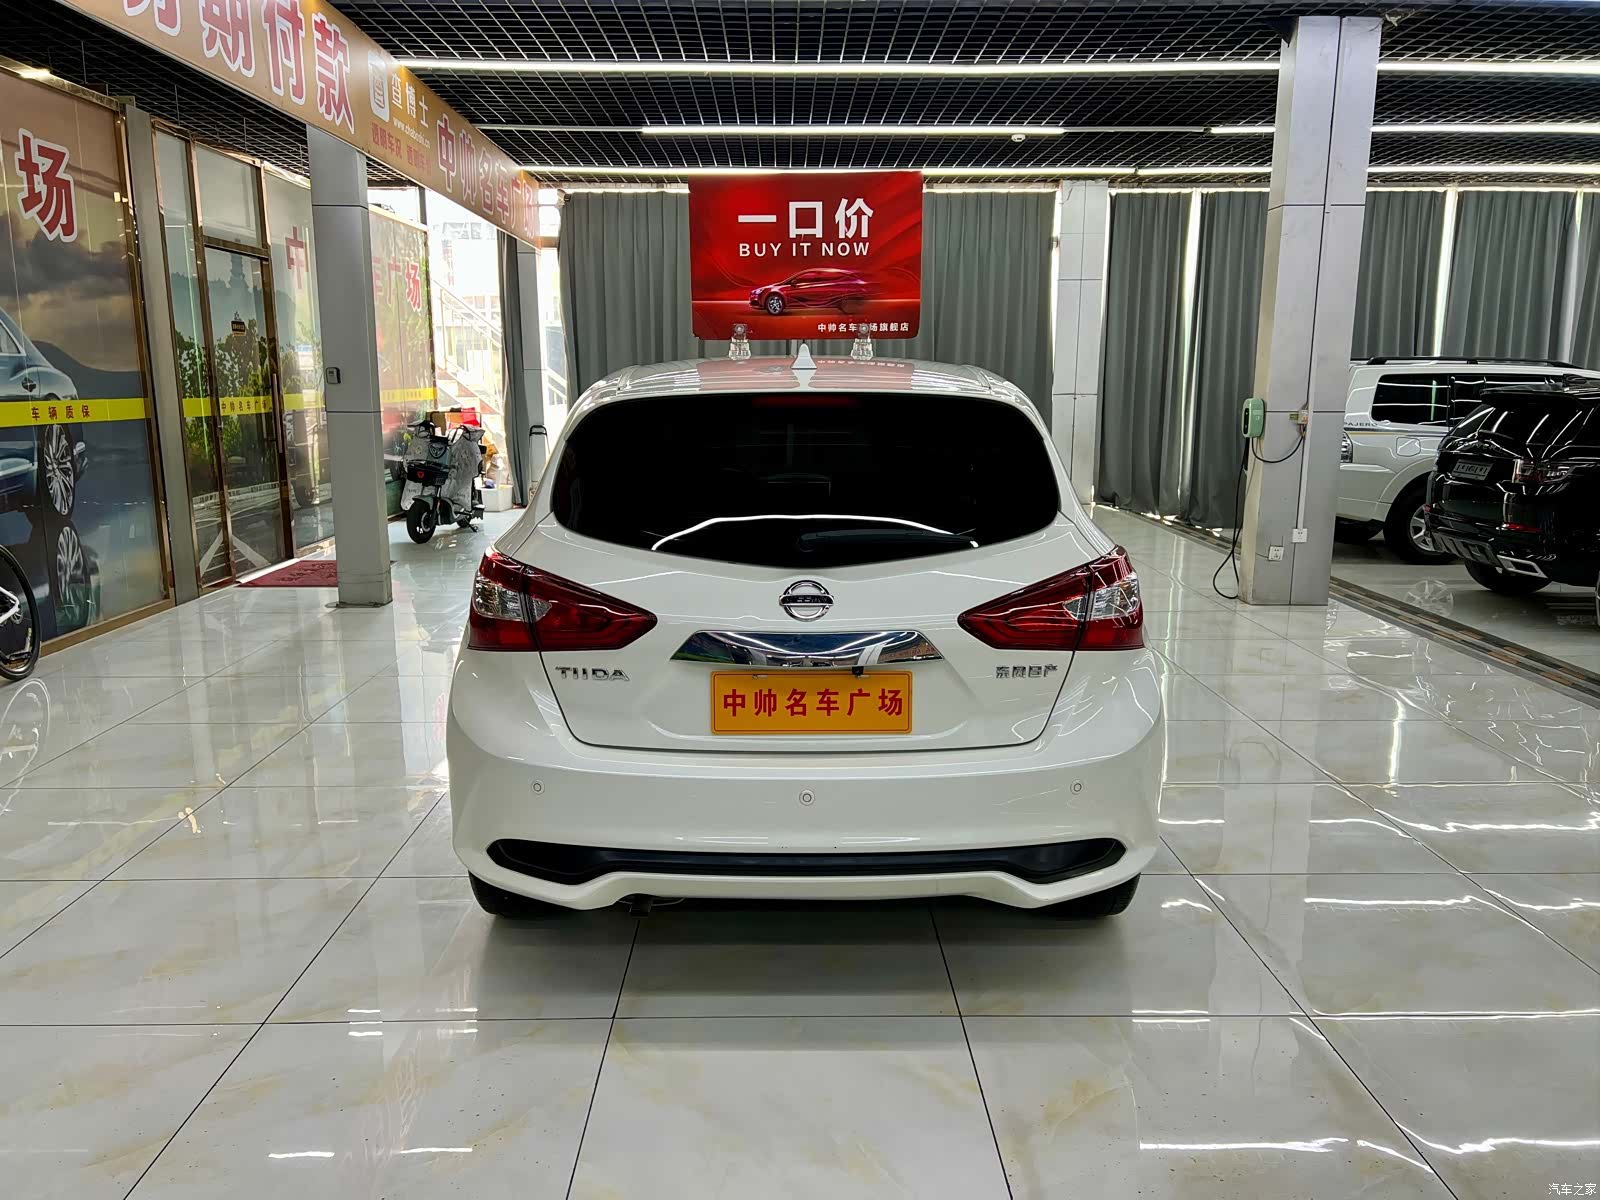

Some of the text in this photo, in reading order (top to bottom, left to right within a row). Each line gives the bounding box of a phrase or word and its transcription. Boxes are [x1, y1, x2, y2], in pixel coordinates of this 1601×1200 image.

[391, 73, 429, 128] 查博士
[15, 128, 78, 242] 场
[437, 113, 536, 239] 中帅名车广场
[737, 198, 874, 239] 一口价
[739, 242, 870, 257] BUY IT NOW
[817, 322, 909, 332] 中帅名车场旗舰店
[31, 404, 91, 422] 车辆质保
[555, 666, 630, 681] TIIDA
[995, 664, 1058, 679] 东风日产
[723, 688, 903, 717] 中帅名车广场
